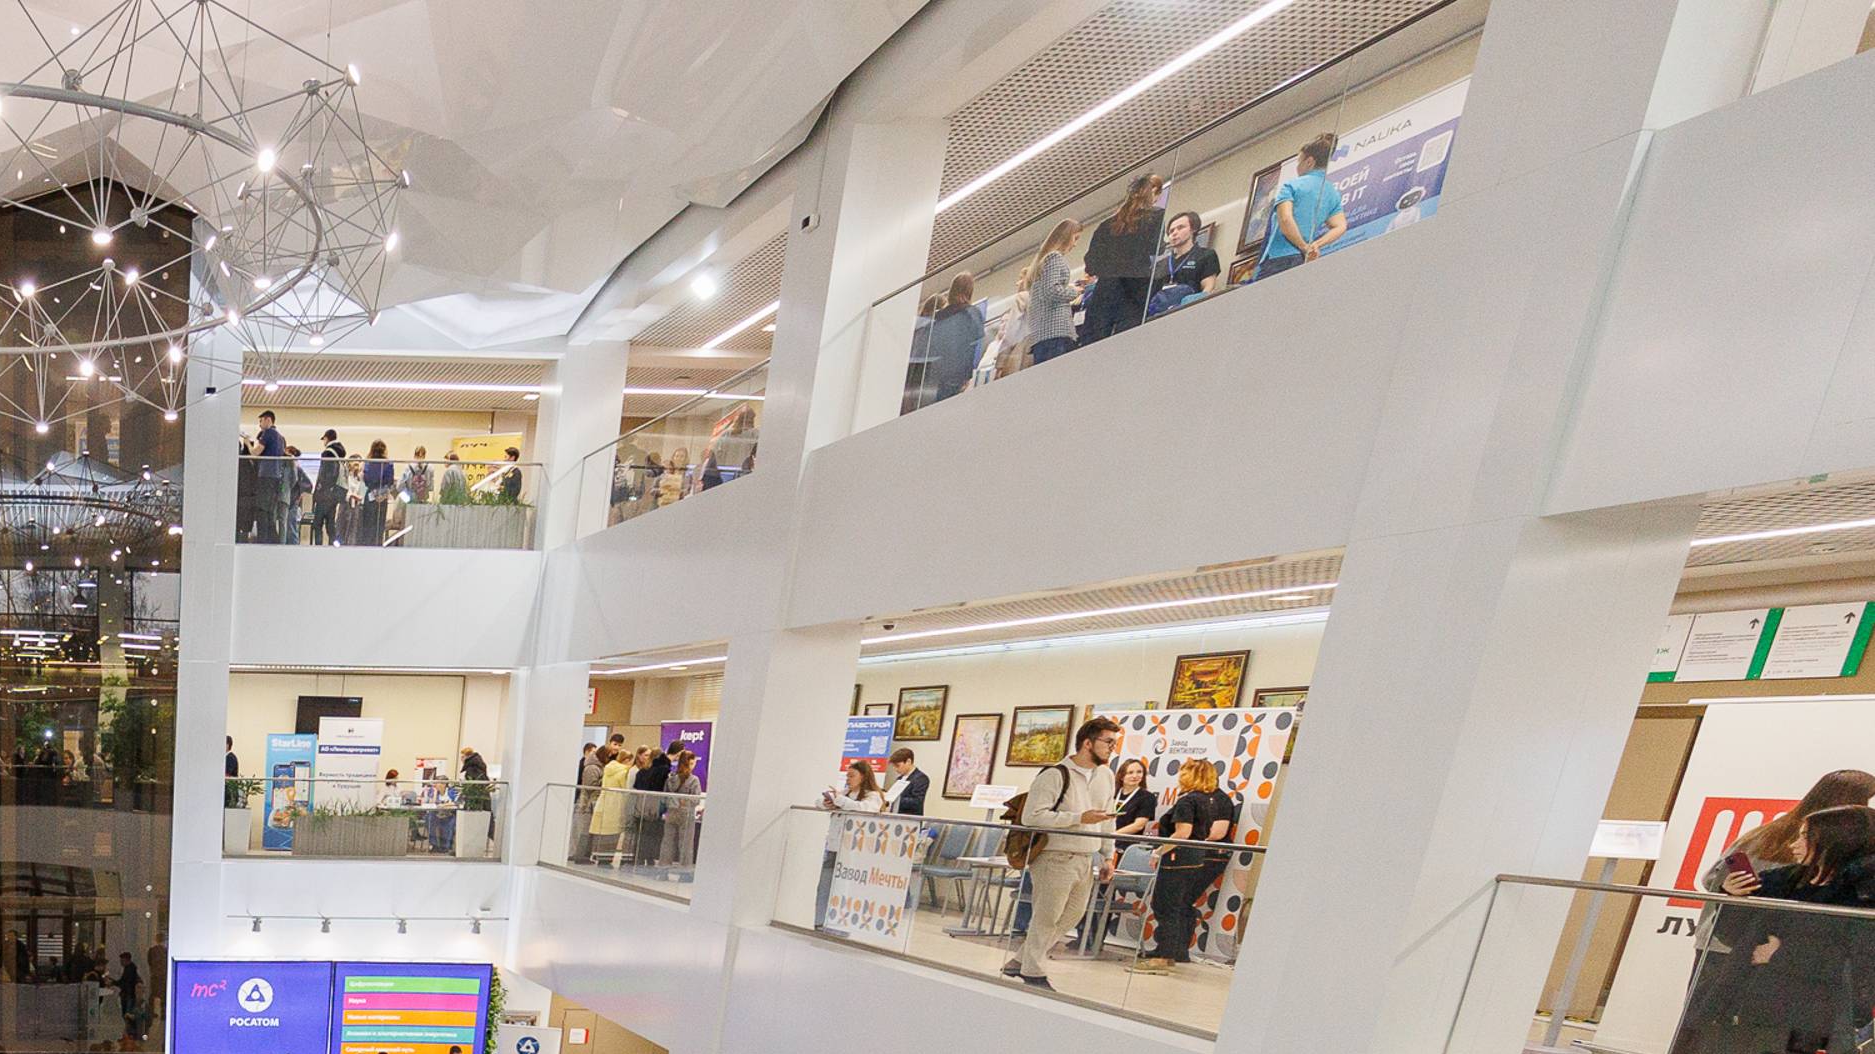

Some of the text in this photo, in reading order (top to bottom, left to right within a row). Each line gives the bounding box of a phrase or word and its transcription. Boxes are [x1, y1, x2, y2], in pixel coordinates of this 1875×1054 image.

[1354, 119, 1412, 152] NAUKA
[271, 738, 311, 748] StarLine
[680, 730, 704, 743] kept
[835, 862, 908, 890] Завод Мечты
[230, 1017, 279, 1027] РОСАТОМ
